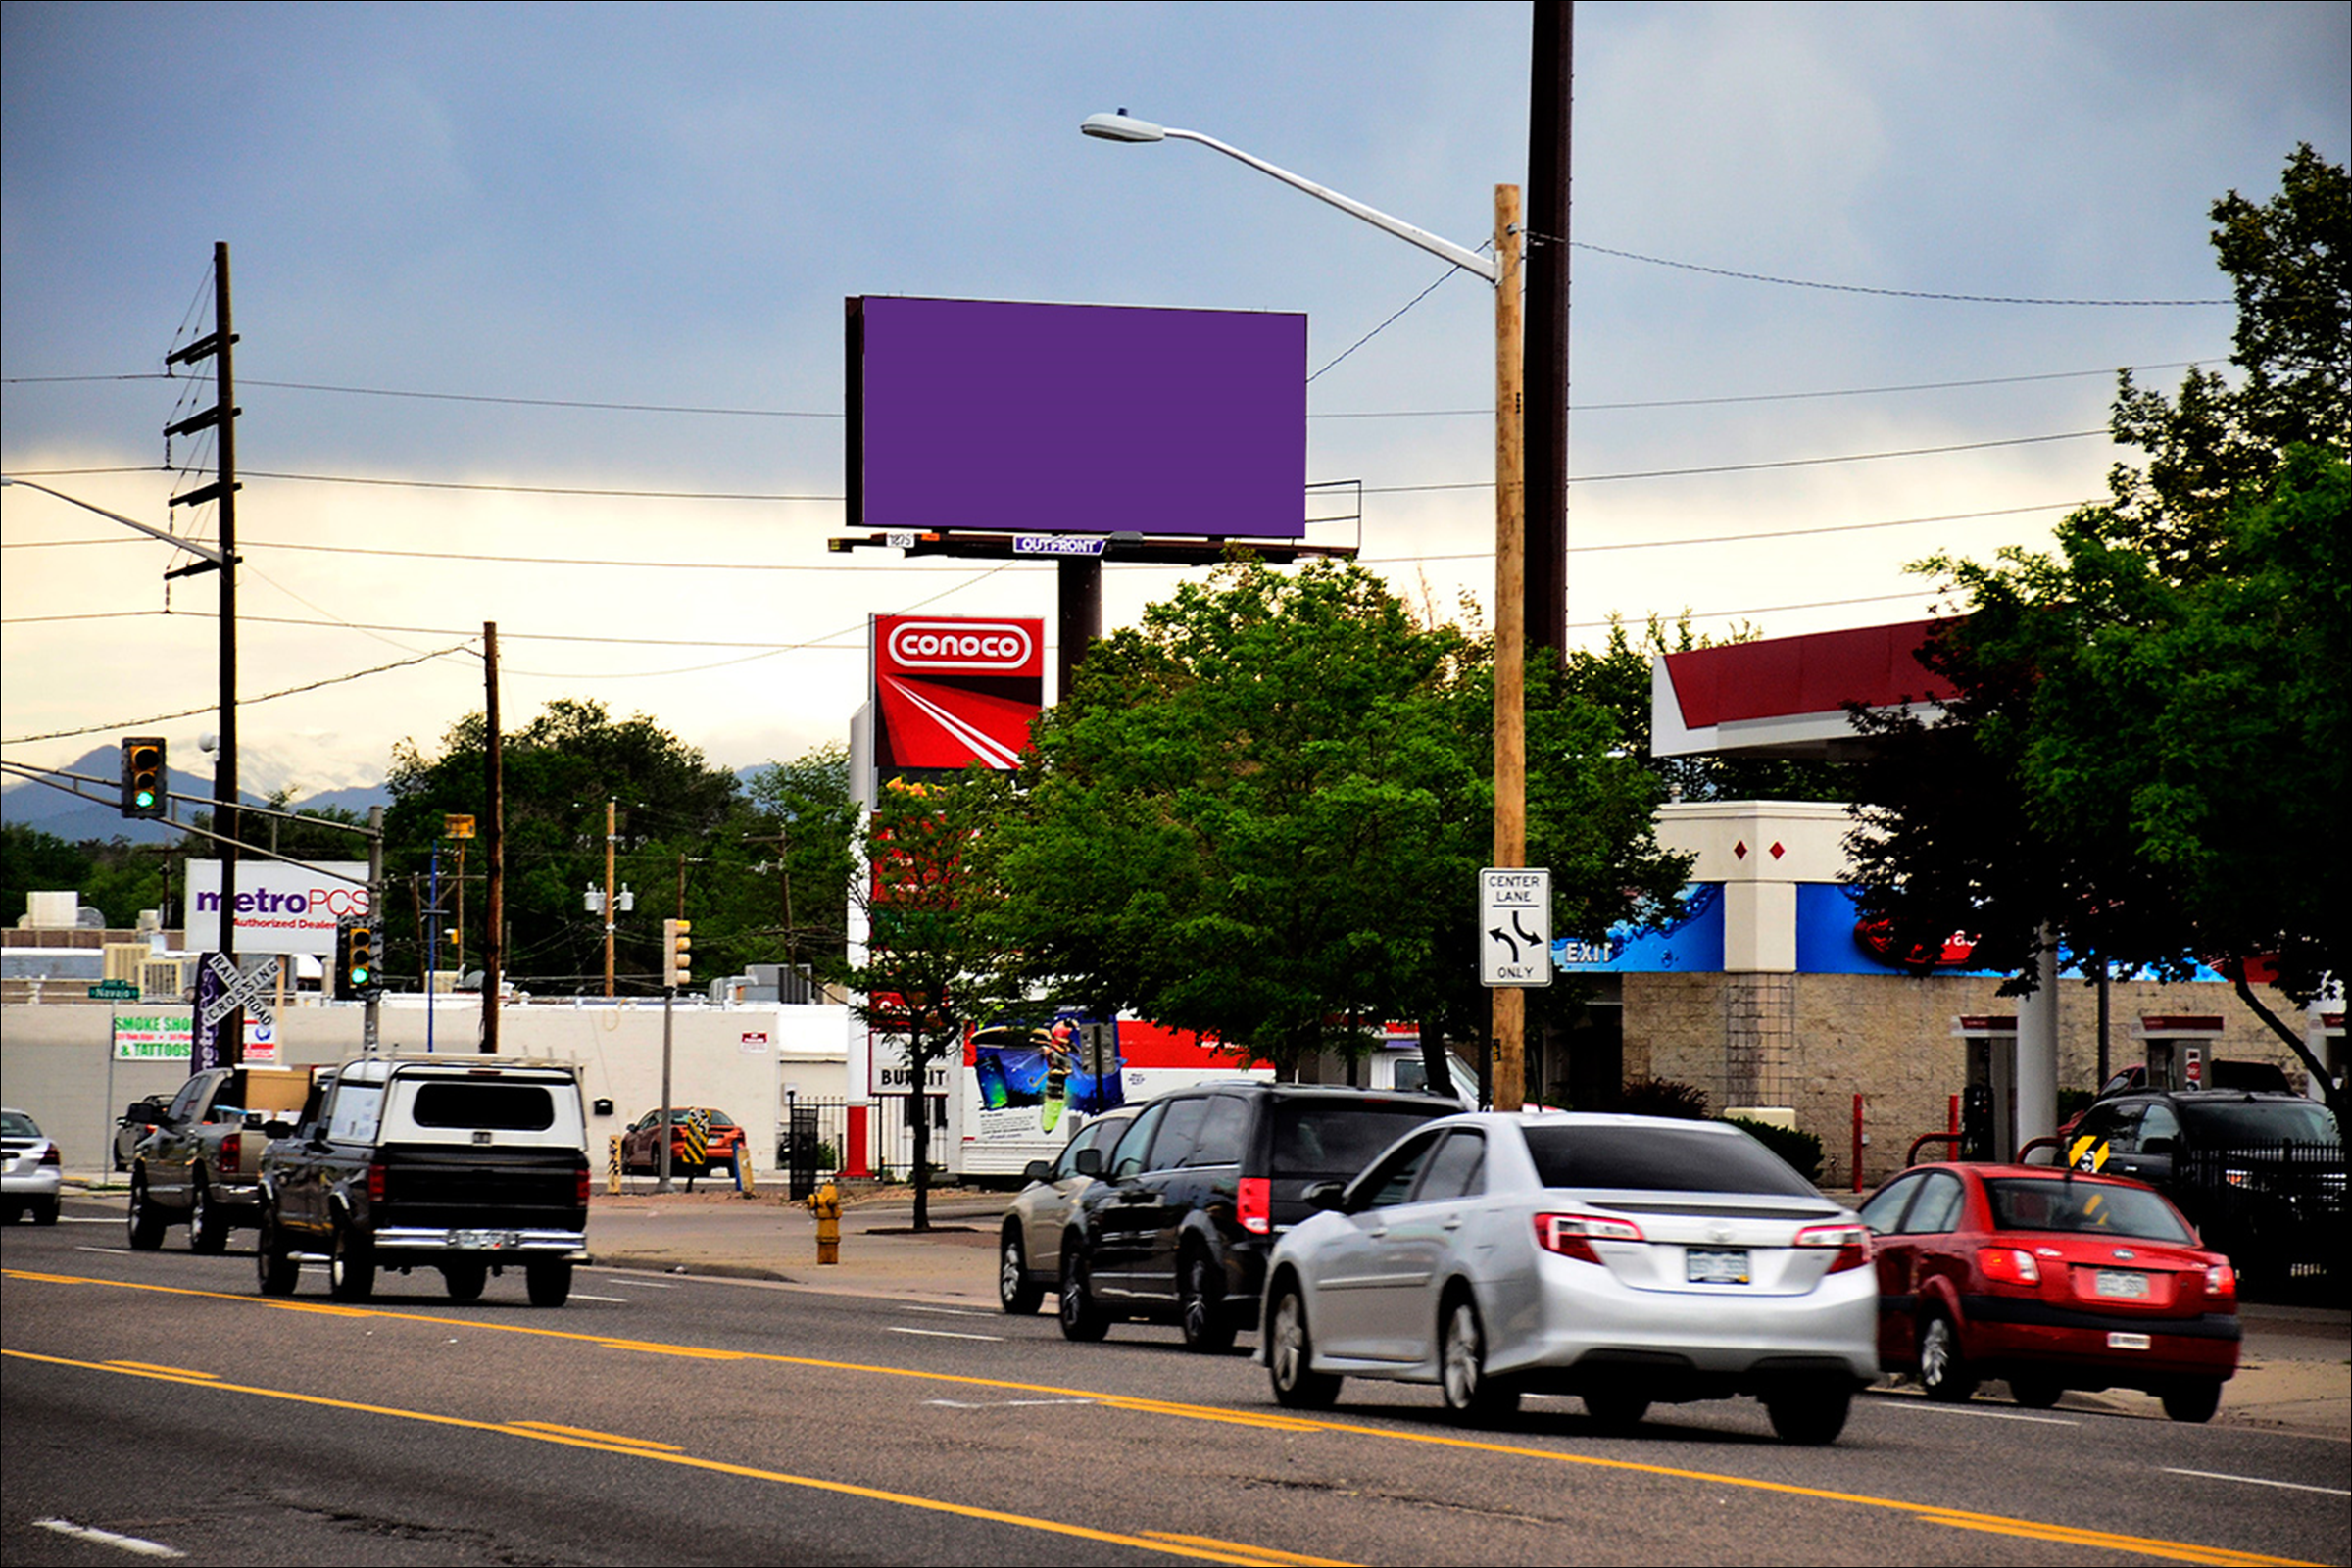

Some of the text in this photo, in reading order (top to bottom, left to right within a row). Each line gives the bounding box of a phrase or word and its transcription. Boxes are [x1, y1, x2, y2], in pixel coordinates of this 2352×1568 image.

[1021, 538, 1097, 552] OUTFRONT
[1488, 875, 1540, 887] CENTER
[1496, 891, 1531, 902] LANE
[234, 917, 336, 930] Authorized Dealer
[1566, 942, 1613, 962] EXIT
[1497, 967, 1534, 979] ONLY
[207, 961, 279, 1020] CROSSING
[115, 1017, 190, 1031] SMOKE SHO
[121, 1043, 191, 1056] & TATTOOS
